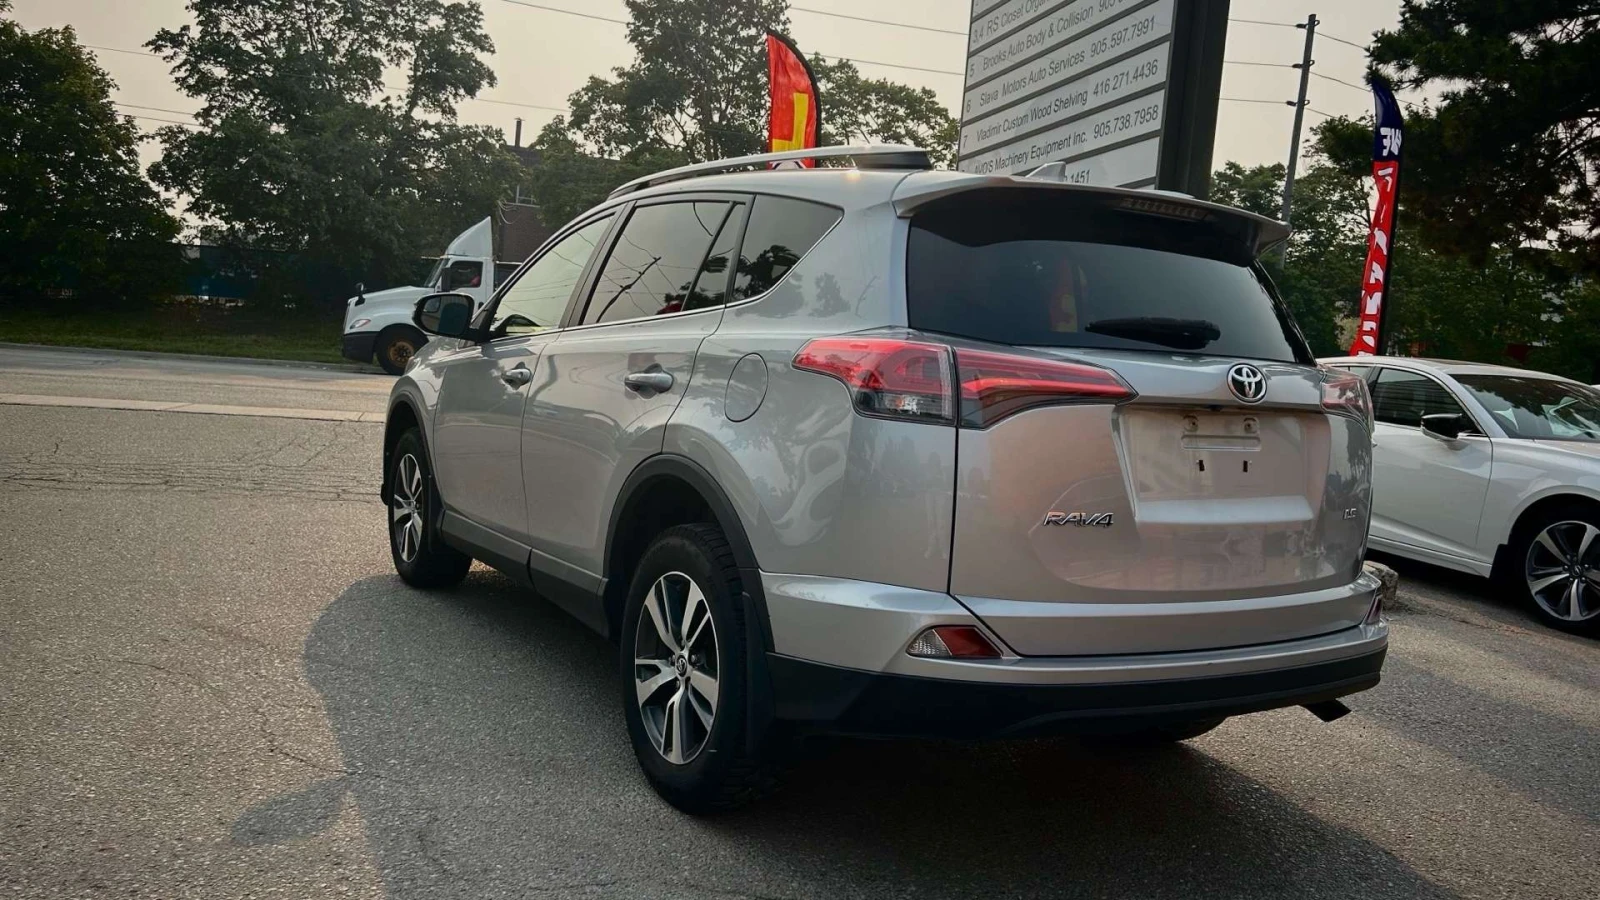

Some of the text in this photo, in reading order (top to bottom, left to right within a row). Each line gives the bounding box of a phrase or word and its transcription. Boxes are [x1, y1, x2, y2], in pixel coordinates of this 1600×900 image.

[969, 63, 975, 78] 5
[983, 49, 1006, 70] Brooks
[1007, 41, 1025, 58] Auto
[1026, 27, 1046, 49] Body
[1047, 22, 1054, 38] &
[1056, 5, 1093, 34] Collision
[987, 16, 999, 36] RS
[1001, 5, 1023, 27] Closet
[1002, 78, 1026, 97] Motors
[1028, 67, 1046, 85] Auto
[1049, 50, 1085, 76] Services
[1091, 15, 1155, 57] 905.597.7991
[963, 134, 968, 148] 7
[977, 122, 1001, 142] Vladimir
[1003, 114, 1028, 132] Custom
[1031, 101, 1052, 121] Wood
[1053, 91, 1088, 114] Shelving
[1093, 78, 1110, 97] 416
[995, 151, 1029, 171] Machinery
[1031, 133, 1071, 160] Equipment
[1073, 131, 1088, 147] Inc.
[1094, 105, 1158, 139] 905.738.7958
[1043, 511, 1114, 528] RAV4
